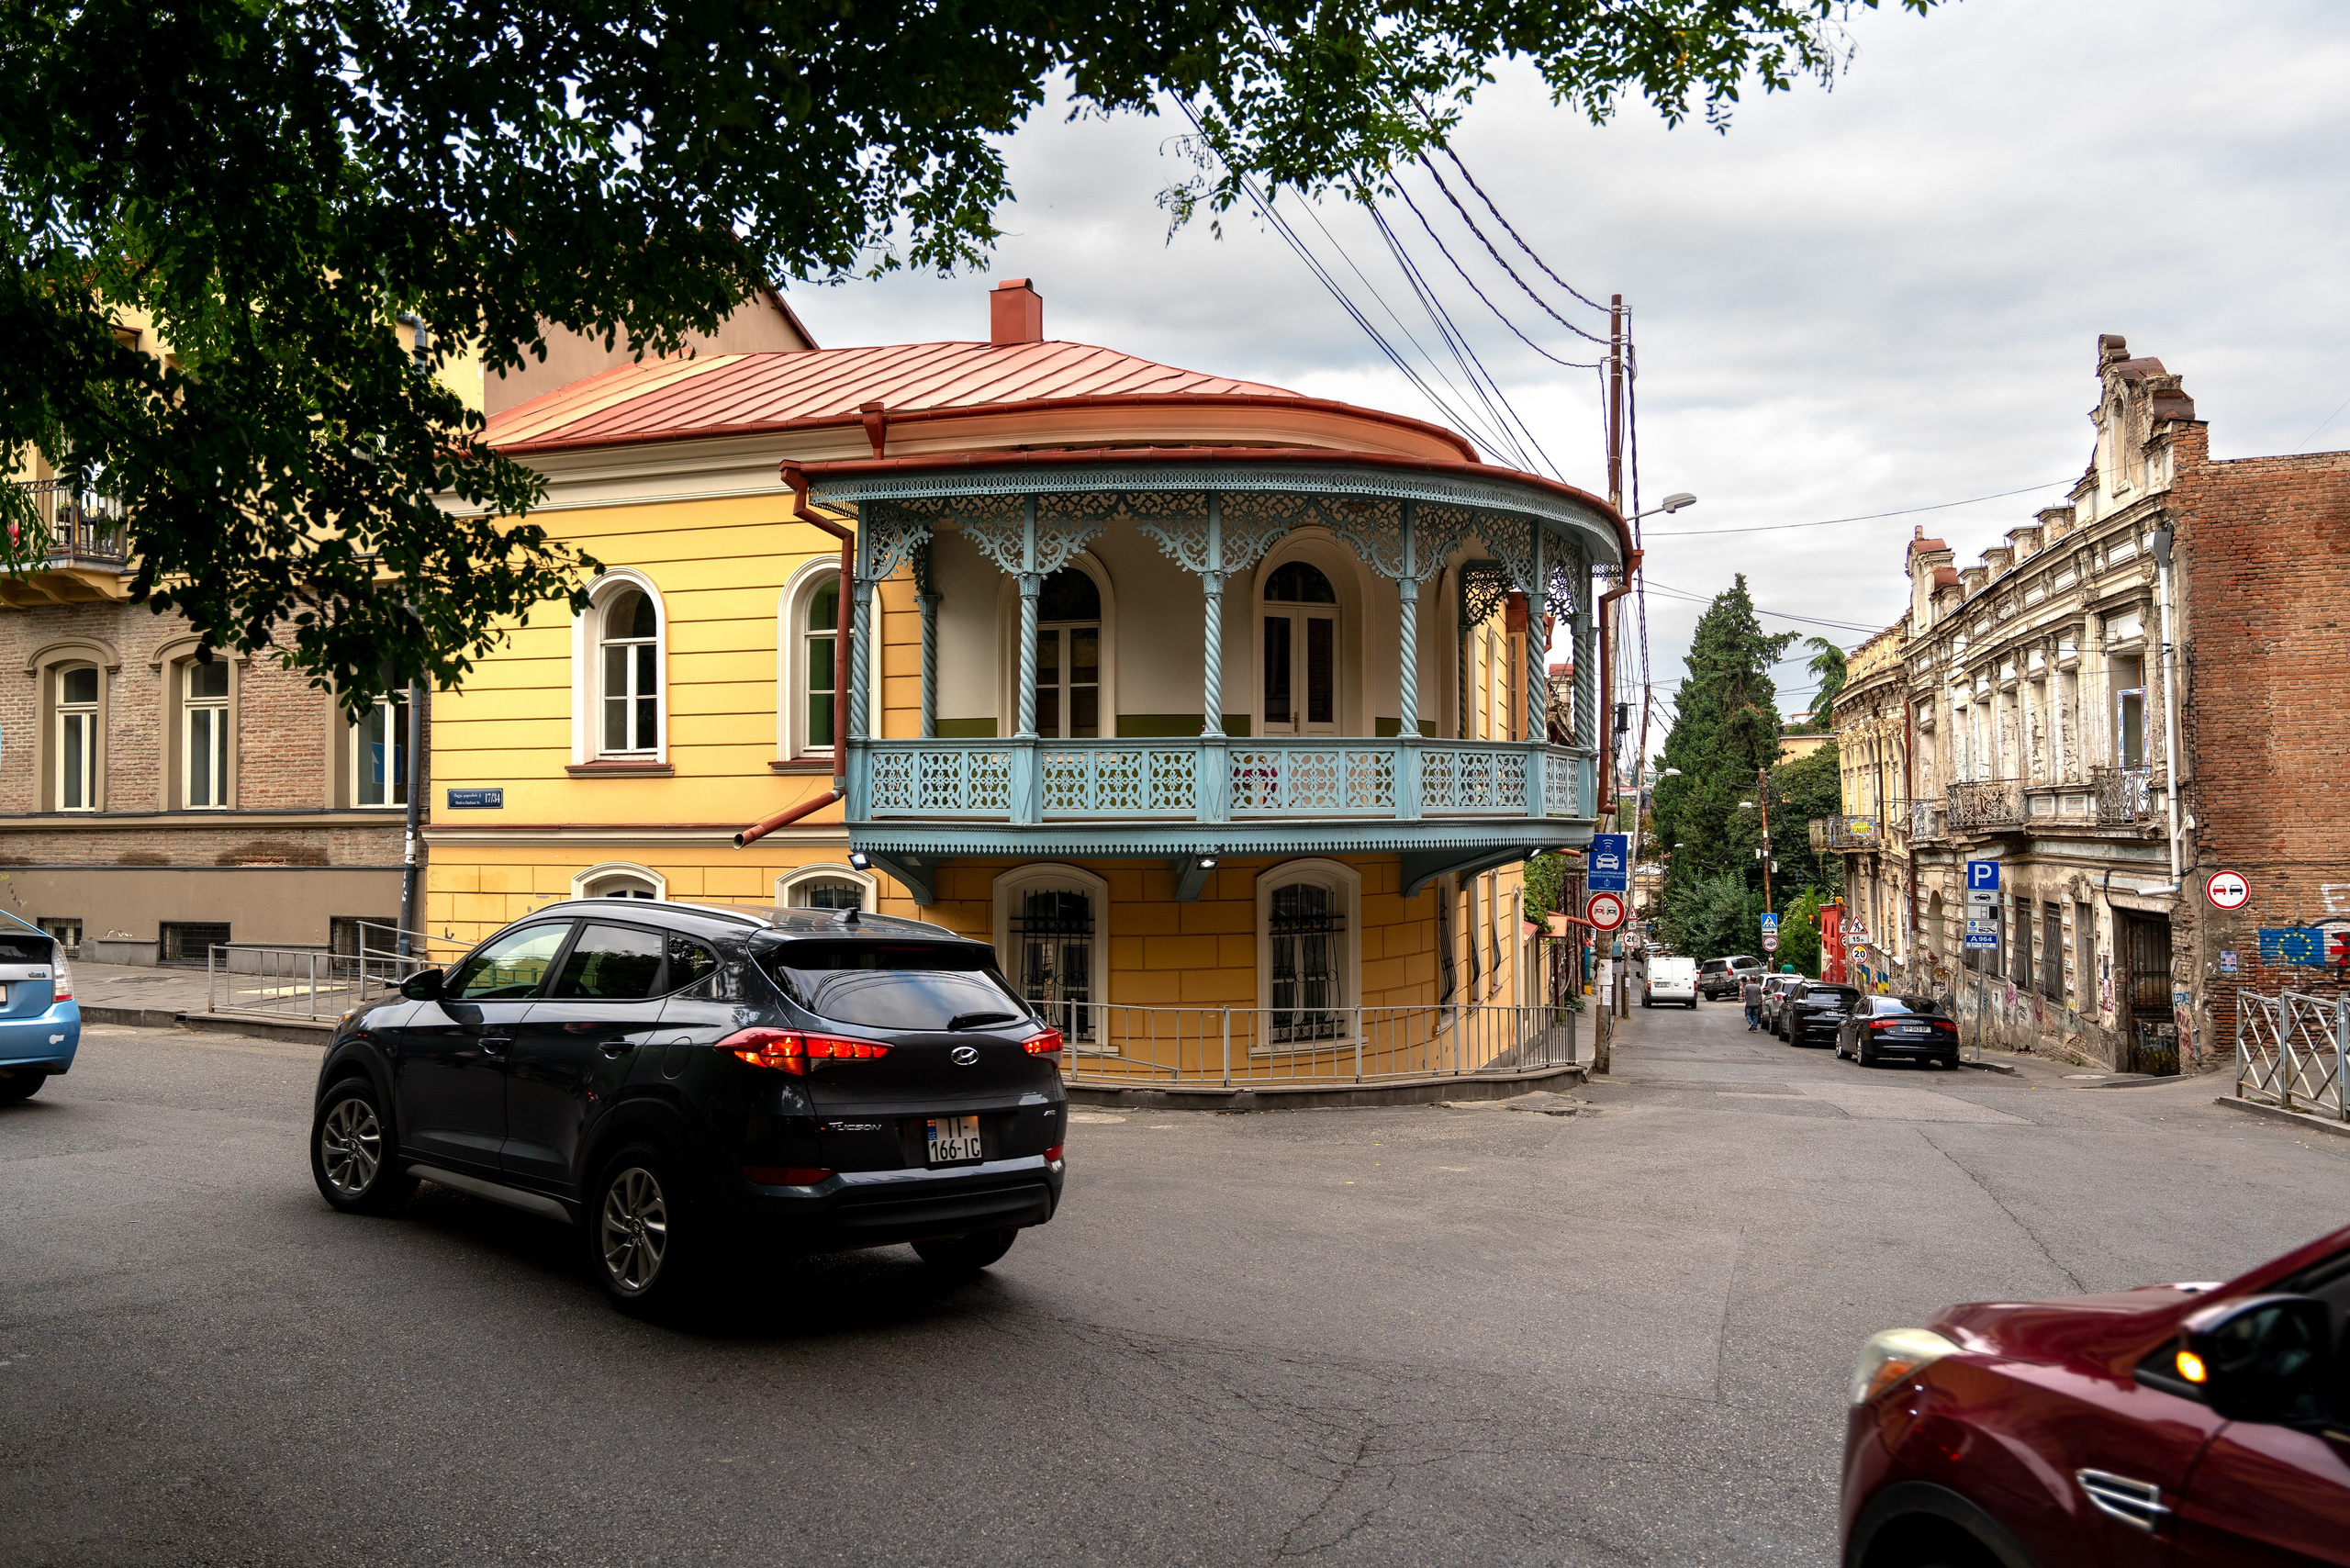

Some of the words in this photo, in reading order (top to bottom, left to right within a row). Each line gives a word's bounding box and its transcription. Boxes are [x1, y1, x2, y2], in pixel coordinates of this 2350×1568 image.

[485, 793, 500, 803] 17/34
[1975, 865, 1992, 887] P
[1854, 950, 1865, 958] 20
[929, 1132, 936, 1140] GE
[931, 1137, 980, 1161] 166-IC
